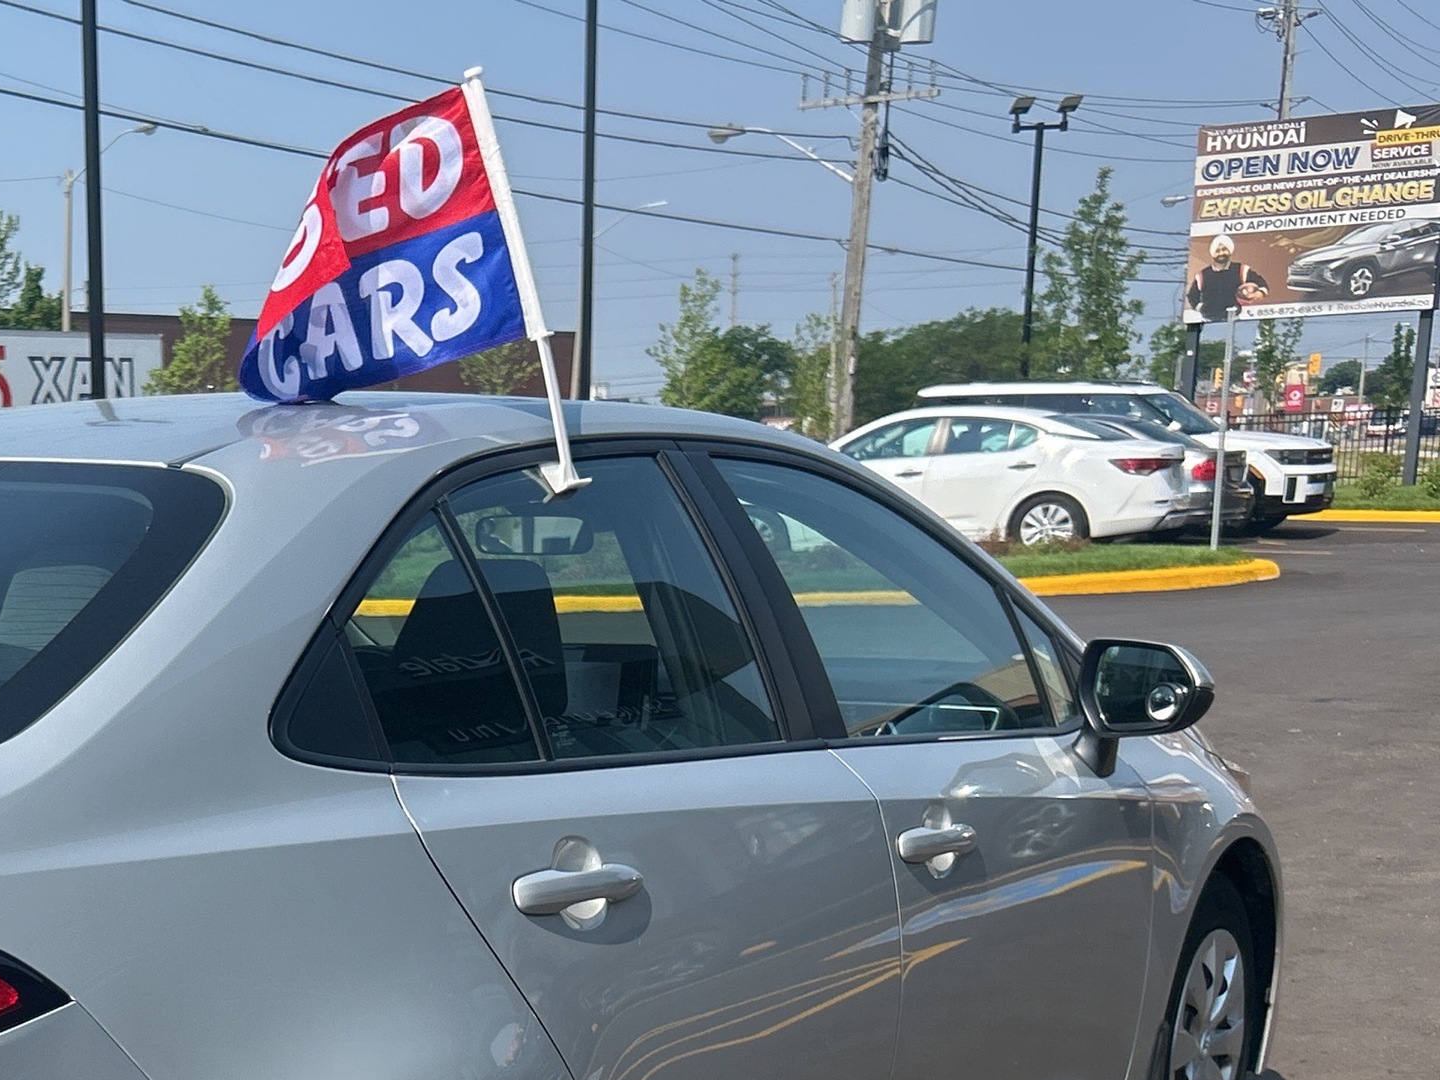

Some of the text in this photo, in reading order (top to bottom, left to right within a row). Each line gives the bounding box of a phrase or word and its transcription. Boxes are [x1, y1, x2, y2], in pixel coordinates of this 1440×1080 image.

[1267, 120, 1307, 131] REXDALE
[1206, 128, 1307, 152] HYUNDAI
[1373, 144, 1430, 159] SERVICE
[1202, 145, 1360, 181] OPEN NOW
[1392, 158, 1433, 167] AVAILABLE
[326, 115, 464, 243] ED
[1197, 185, 1251, 197] EXPERIENCE
[1252, 183, 1272, 192] OUR
[1273, 181, 1295, 190] NEW
[1296, 173, 1382, 188] STATE-OF-THE-ART
[1199, 179, 1436, 219] EXPRESS OIL CHANGE
[1223, 208, 1406, 232] NO APPOINTMENT NEEDED
[257, 231, 484, 400] CARS
